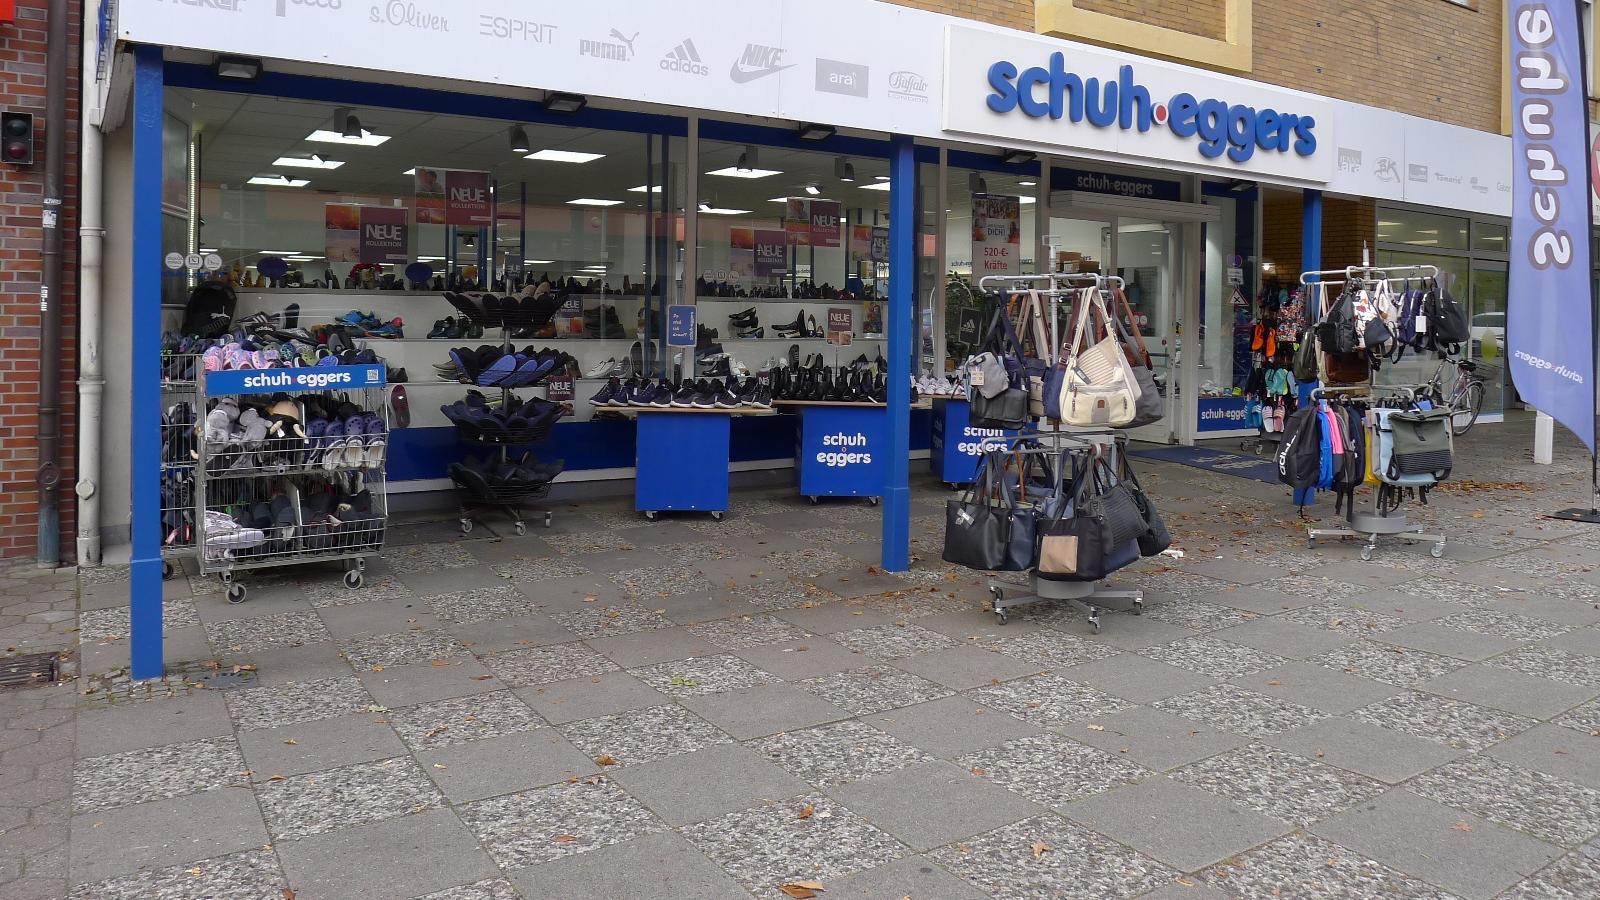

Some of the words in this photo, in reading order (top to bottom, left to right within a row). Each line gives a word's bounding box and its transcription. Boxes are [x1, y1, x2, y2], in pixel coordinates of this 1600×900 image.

[479, 14, 558, 45] ESPRIT
[579, 39, 629, 61] PUMA
[740, 43, 786, 67] NIKE
[659, 57, 709, 77] adidas
[828, 72, 854, 86] ara
[888, 71, 929, 93] Buffalo
[450, 187, 485, 203] NEUE
[813, 214, 837, 228] NEUE
[365, 224, 402, 241] NEUE
[757, 243, 783, 258] NEUE
[984, 260, 1008, 270] Kräfte
[830, 312, 850, 323] NEUE
[549, 381, 571, 391] NEUE
[823, 432, 866, 446] schuh
[816, 451, 872, 467] eggers
